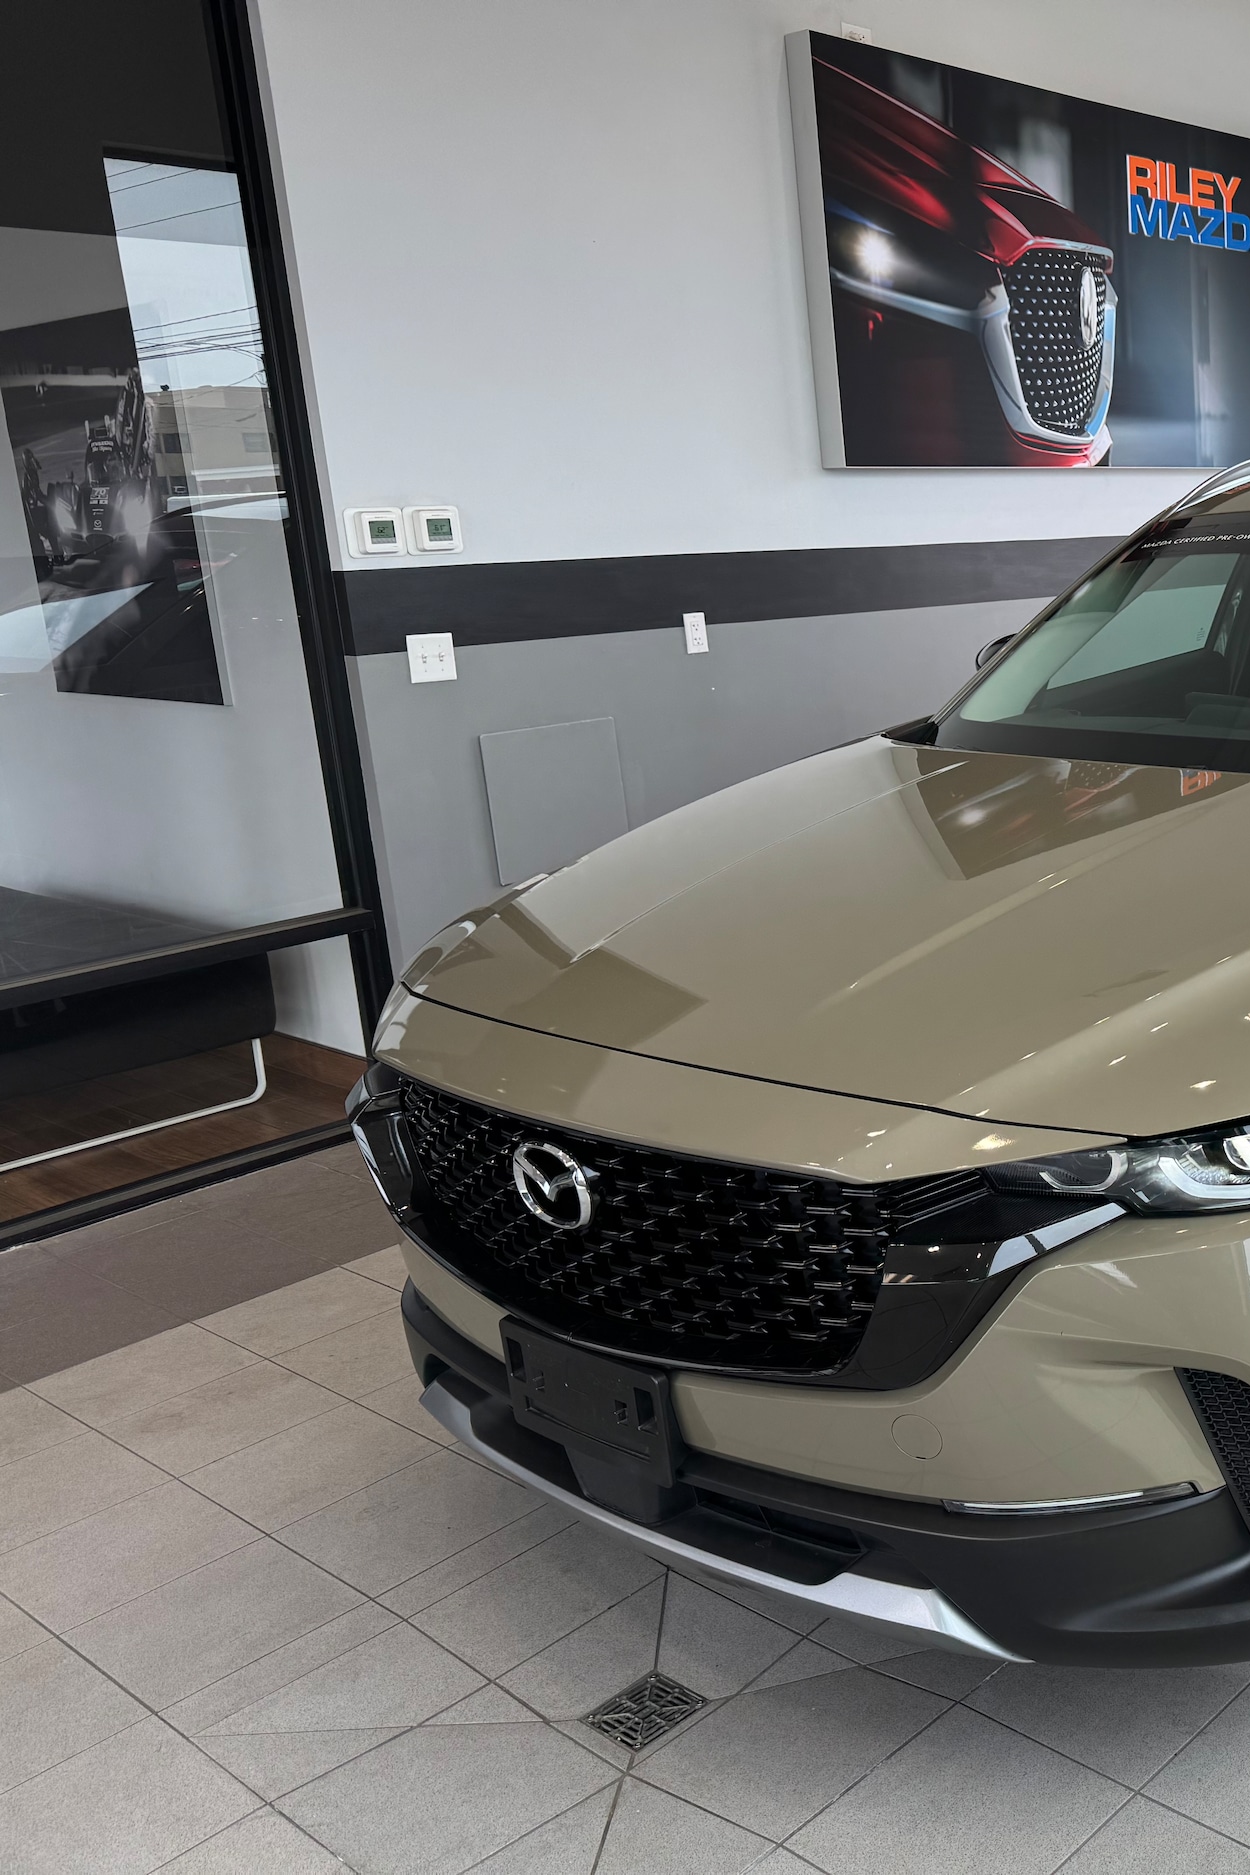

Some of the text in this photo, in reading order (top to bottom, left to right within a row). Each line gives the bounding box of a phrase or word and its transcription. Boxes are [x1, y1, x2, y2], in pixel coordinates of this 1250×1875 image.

[1126, 154, 1242, 213] RILEY
[1141, 539, 1172, 549] MAZDA
[1173, 535, 1215, 544] CERTIFIED
